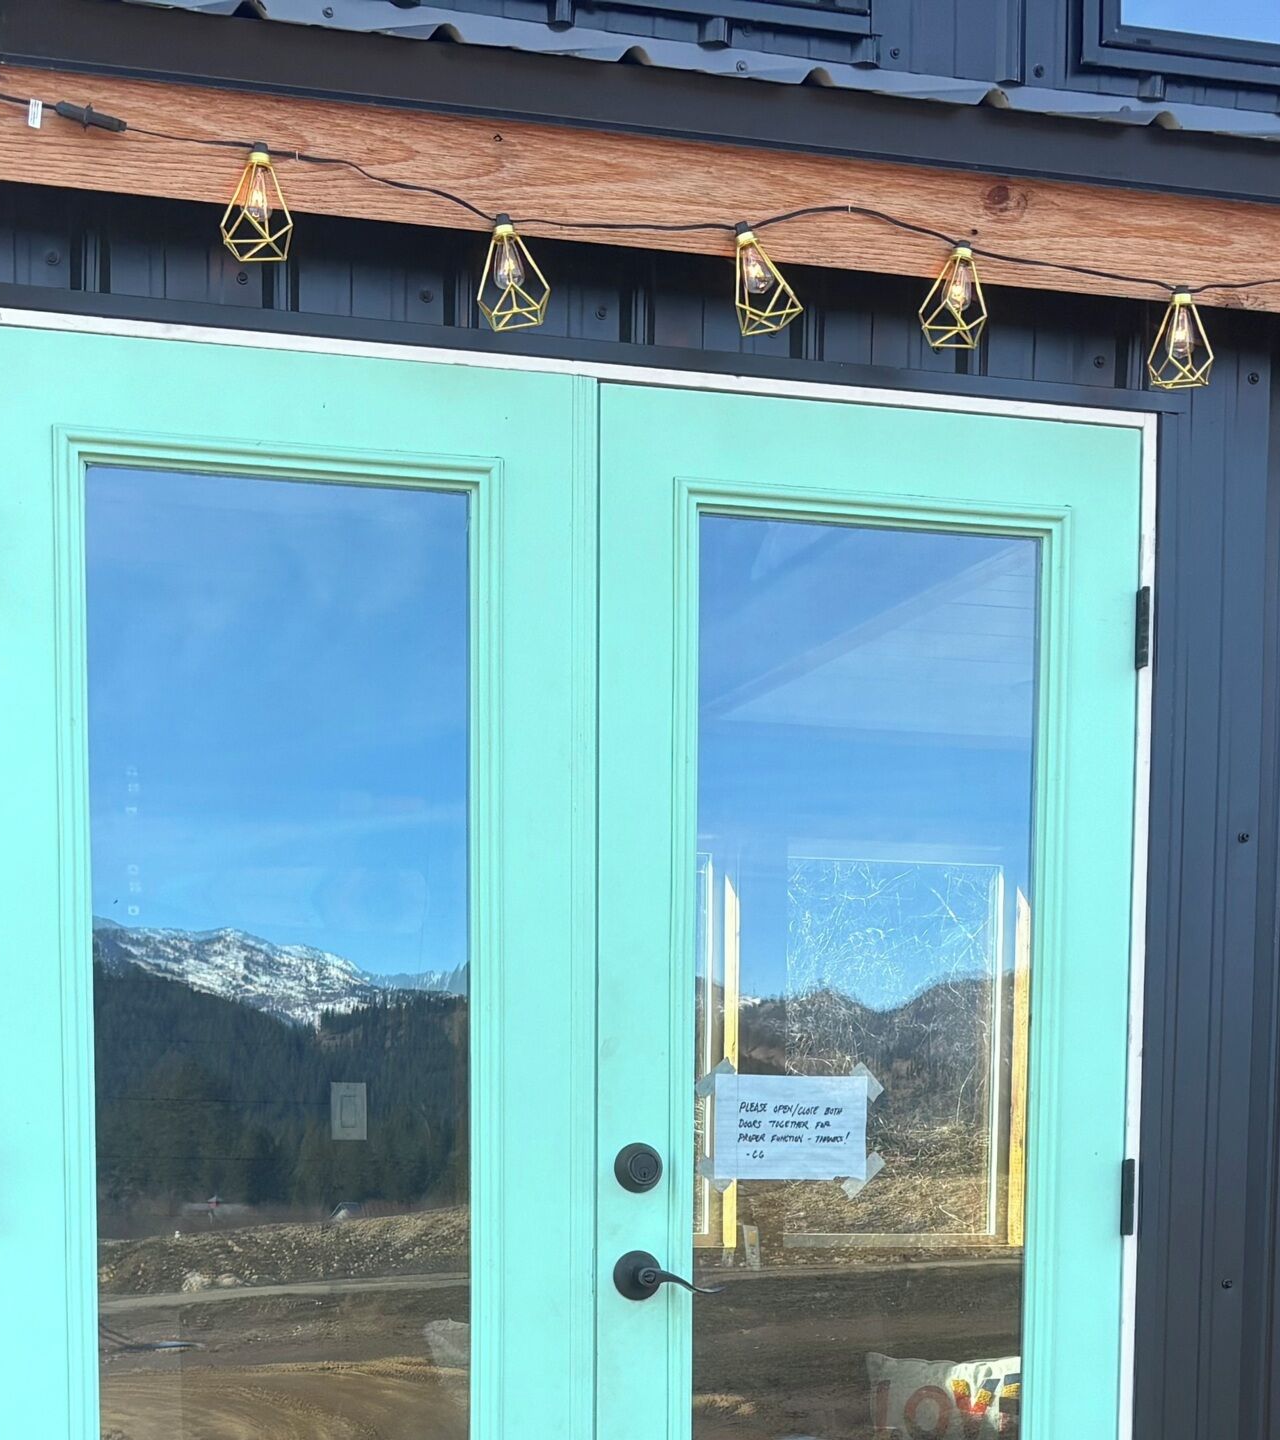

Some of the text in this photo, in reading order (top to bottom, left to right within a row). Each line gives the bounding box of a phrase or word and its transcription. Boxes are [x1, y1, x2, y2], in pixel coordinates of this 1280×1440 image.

[739, 1101, 768, 1113] PLEASE
[823, 1106, 843, 1116] BOTH
[738, 1118, 831, 1130] DOORS TOGETHER FOR
[737, 1133, 766, 1143] PROPER
[770, 1134, 804, 1143] FUNCTION
